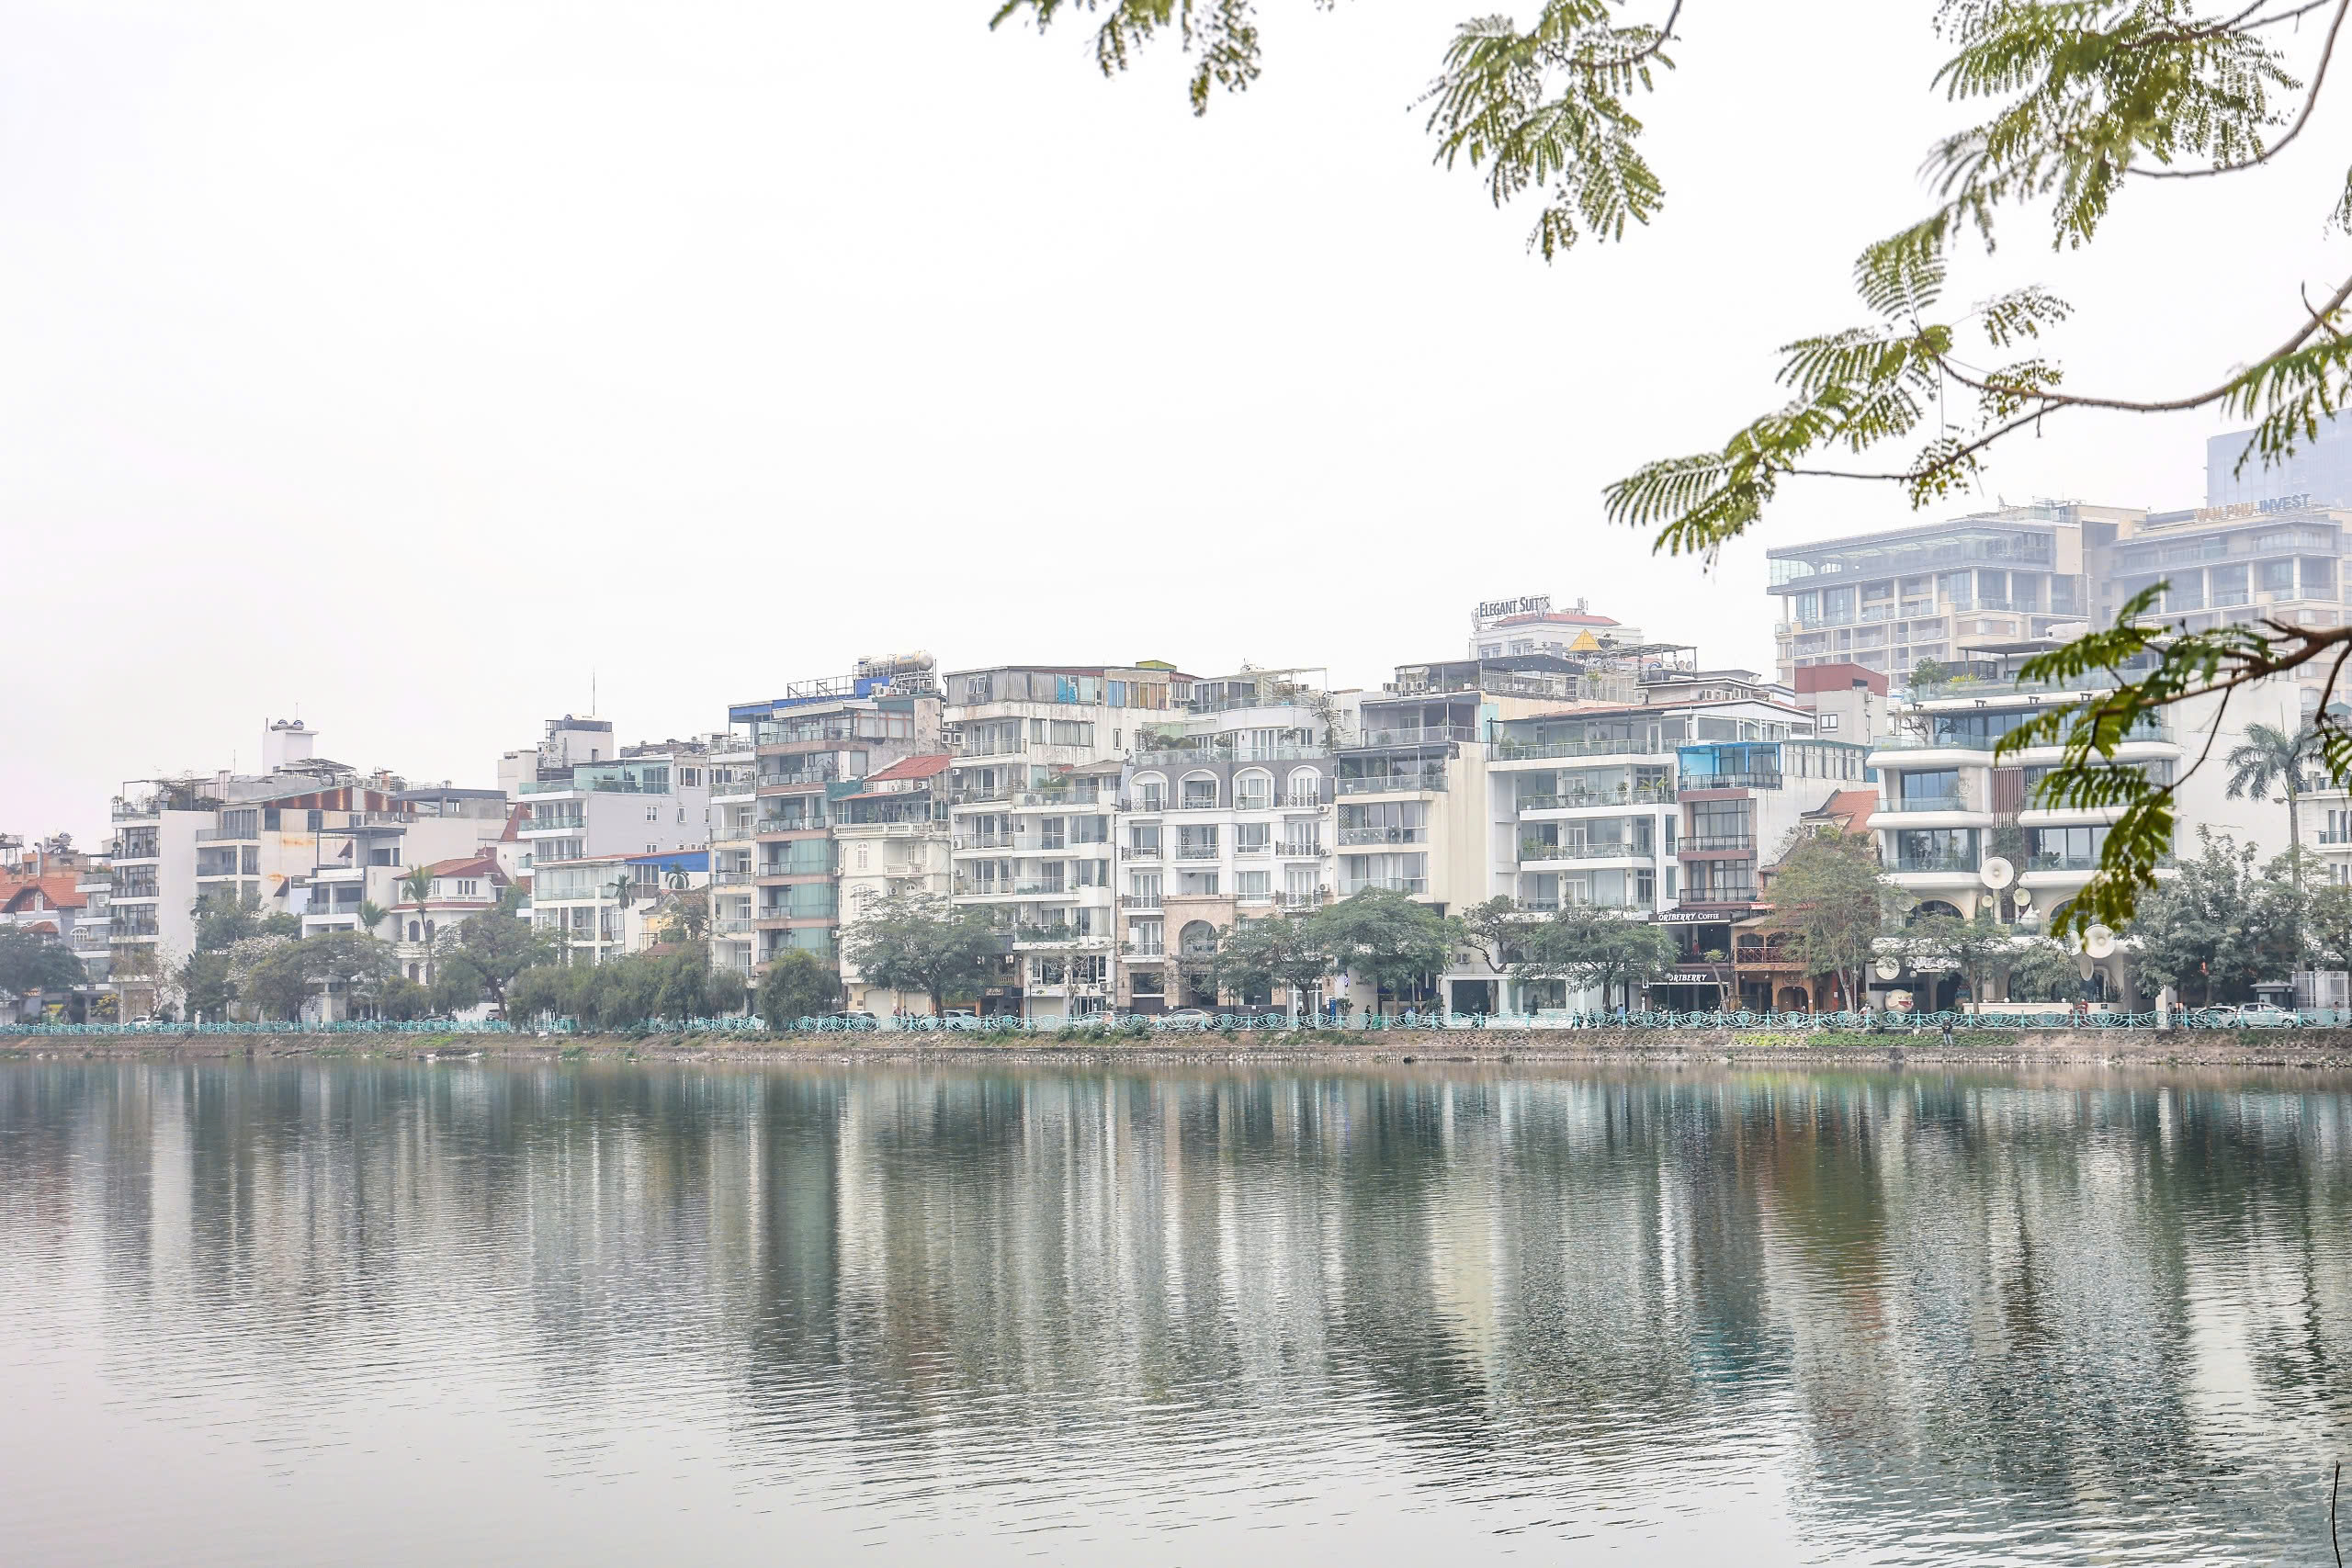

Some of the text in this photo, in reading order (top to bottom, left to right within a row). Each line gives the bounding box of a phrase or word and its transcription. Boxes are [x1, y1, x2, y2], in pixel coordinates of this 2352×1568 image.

[2259, 493, 2312, 513] INVEST
[1479, 600, 1518, 617] ELEGANT
[1658, 912, 1696, 921] ORIBERRY
